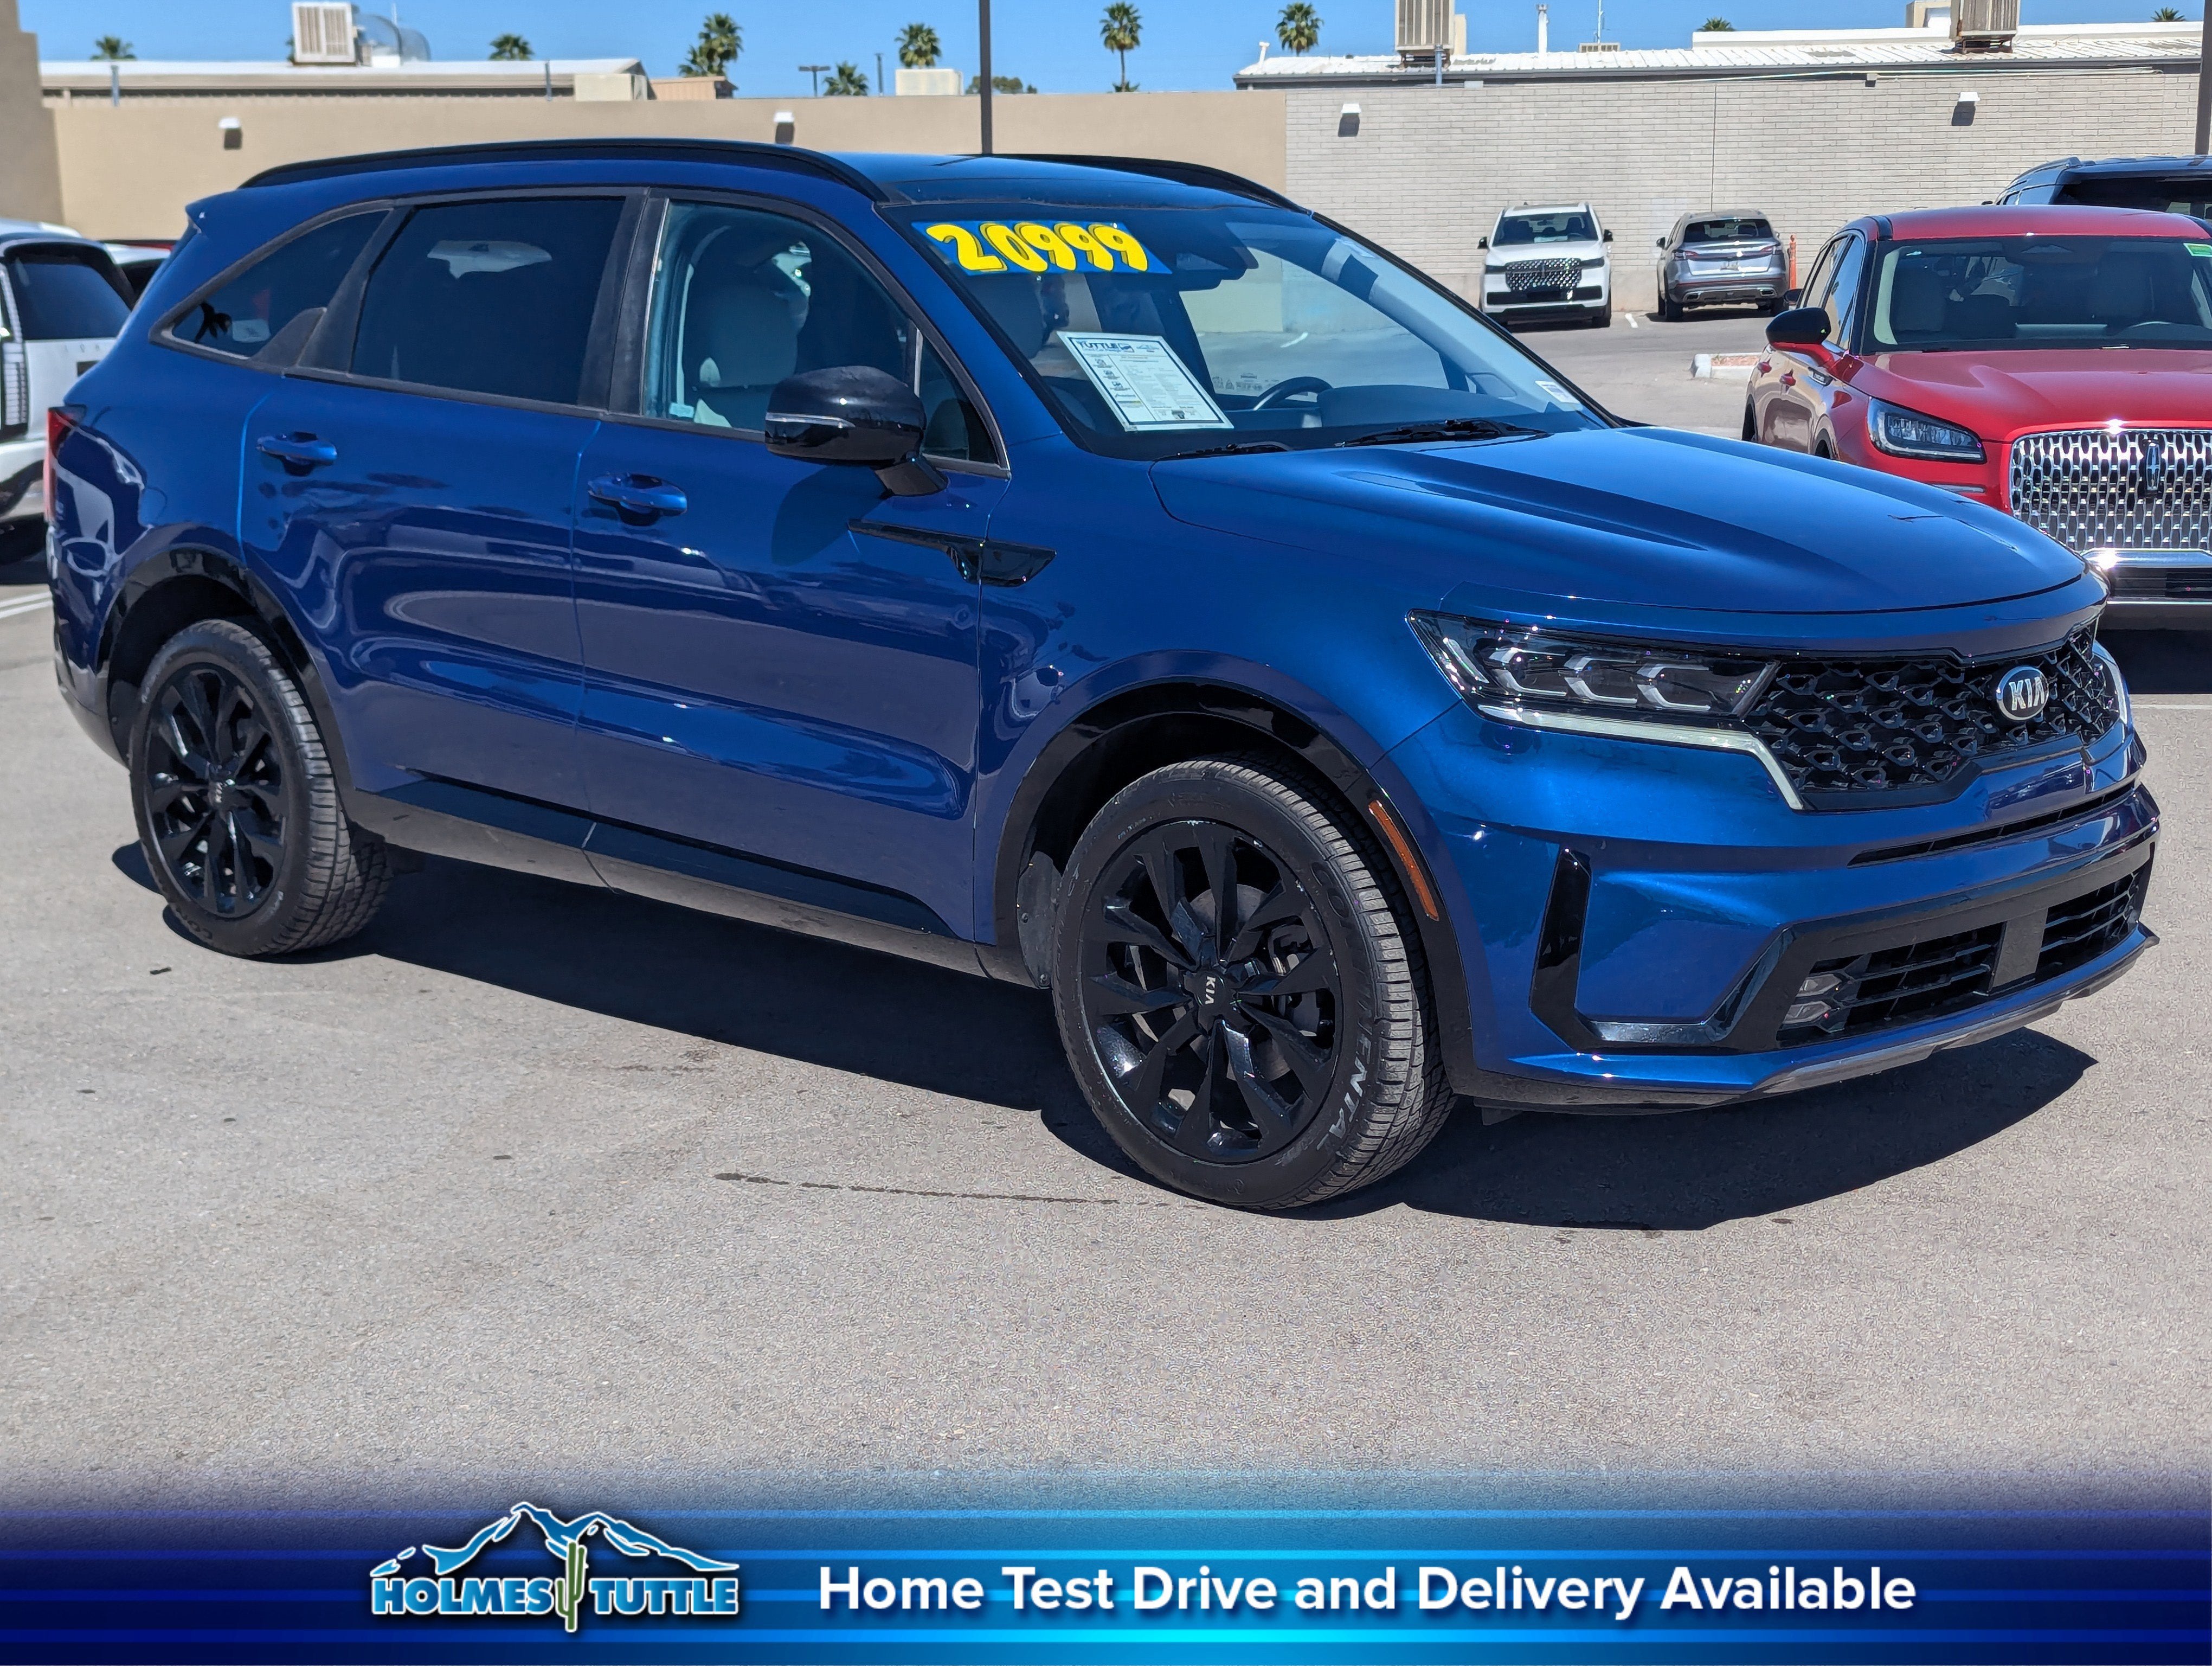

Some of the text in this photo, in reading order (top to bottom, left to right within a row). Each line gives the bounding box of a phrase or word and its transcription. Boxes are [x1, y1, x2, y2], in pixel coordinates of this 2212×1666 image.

[926, 221, 1148, 272] 20999
[2009, 676, 2045, 711] KIA
[1205, 976, 1216, 1005] KIA
